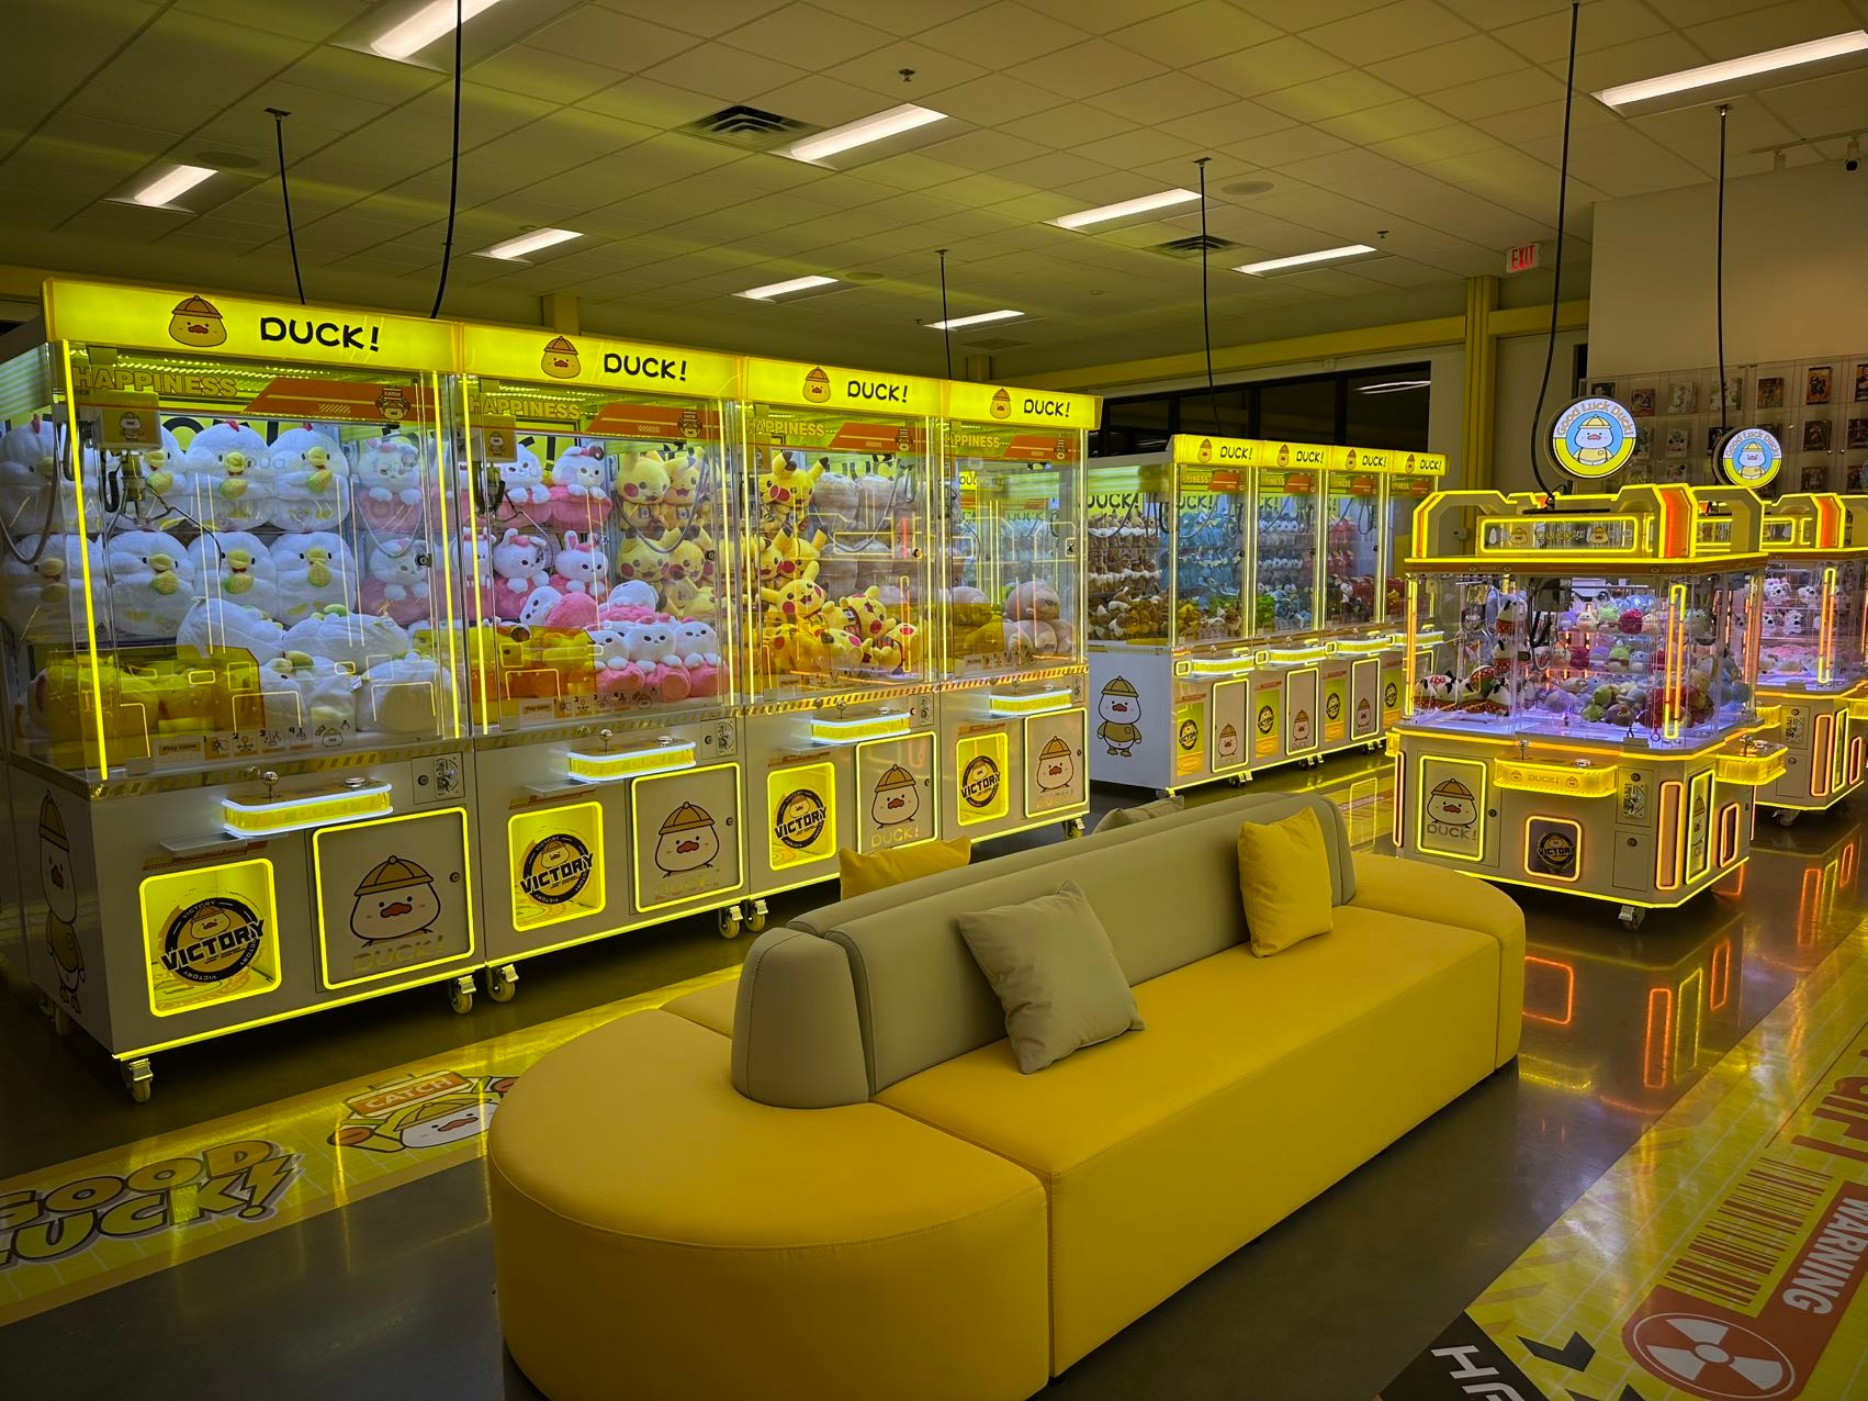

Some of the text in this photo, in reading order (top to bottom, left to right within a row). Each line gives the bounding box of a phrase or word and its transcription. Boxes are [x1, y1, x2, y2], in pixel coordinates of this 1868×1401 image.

[260, 316, 379, 352] DUCK!
[603, 353, 687, 382] DUCK!
[72, 367, 238, 398] HAPPINESS
[847, 380, 909, 403] DUCK!
[468, 394, 582, 420] HAPPINESS
[1023, 399, 1071, 418] DUCK!
[1556, 406, 1581, 436] Good
[1580, 400, 1610, 413] Luck
[1219, 446, 1254, 460] DUCK!
[1296, 451, 1324, 464] DUCK!
[1362, 455, 1387, 468] DUCK!
[1419, 459, 1442, 471] DUCK!
[960, 771, 1002, 800] VICTORY
[1528, 773, 1560, 785] DUCK!
[774, 805, 828, 839] VICTORY
[1426, 822, 1478, 841] DUCK!
[871, 826, 919, 848] DUCK!
[519, 852, 594, 895] VICTORY
[161, 918, 265, 972] VICTORY
[353, 933, 445, 973] DUCK!
[365, 1076, 453, 1110] CATCH
[0, 1153, 298, 1268] UCK!
